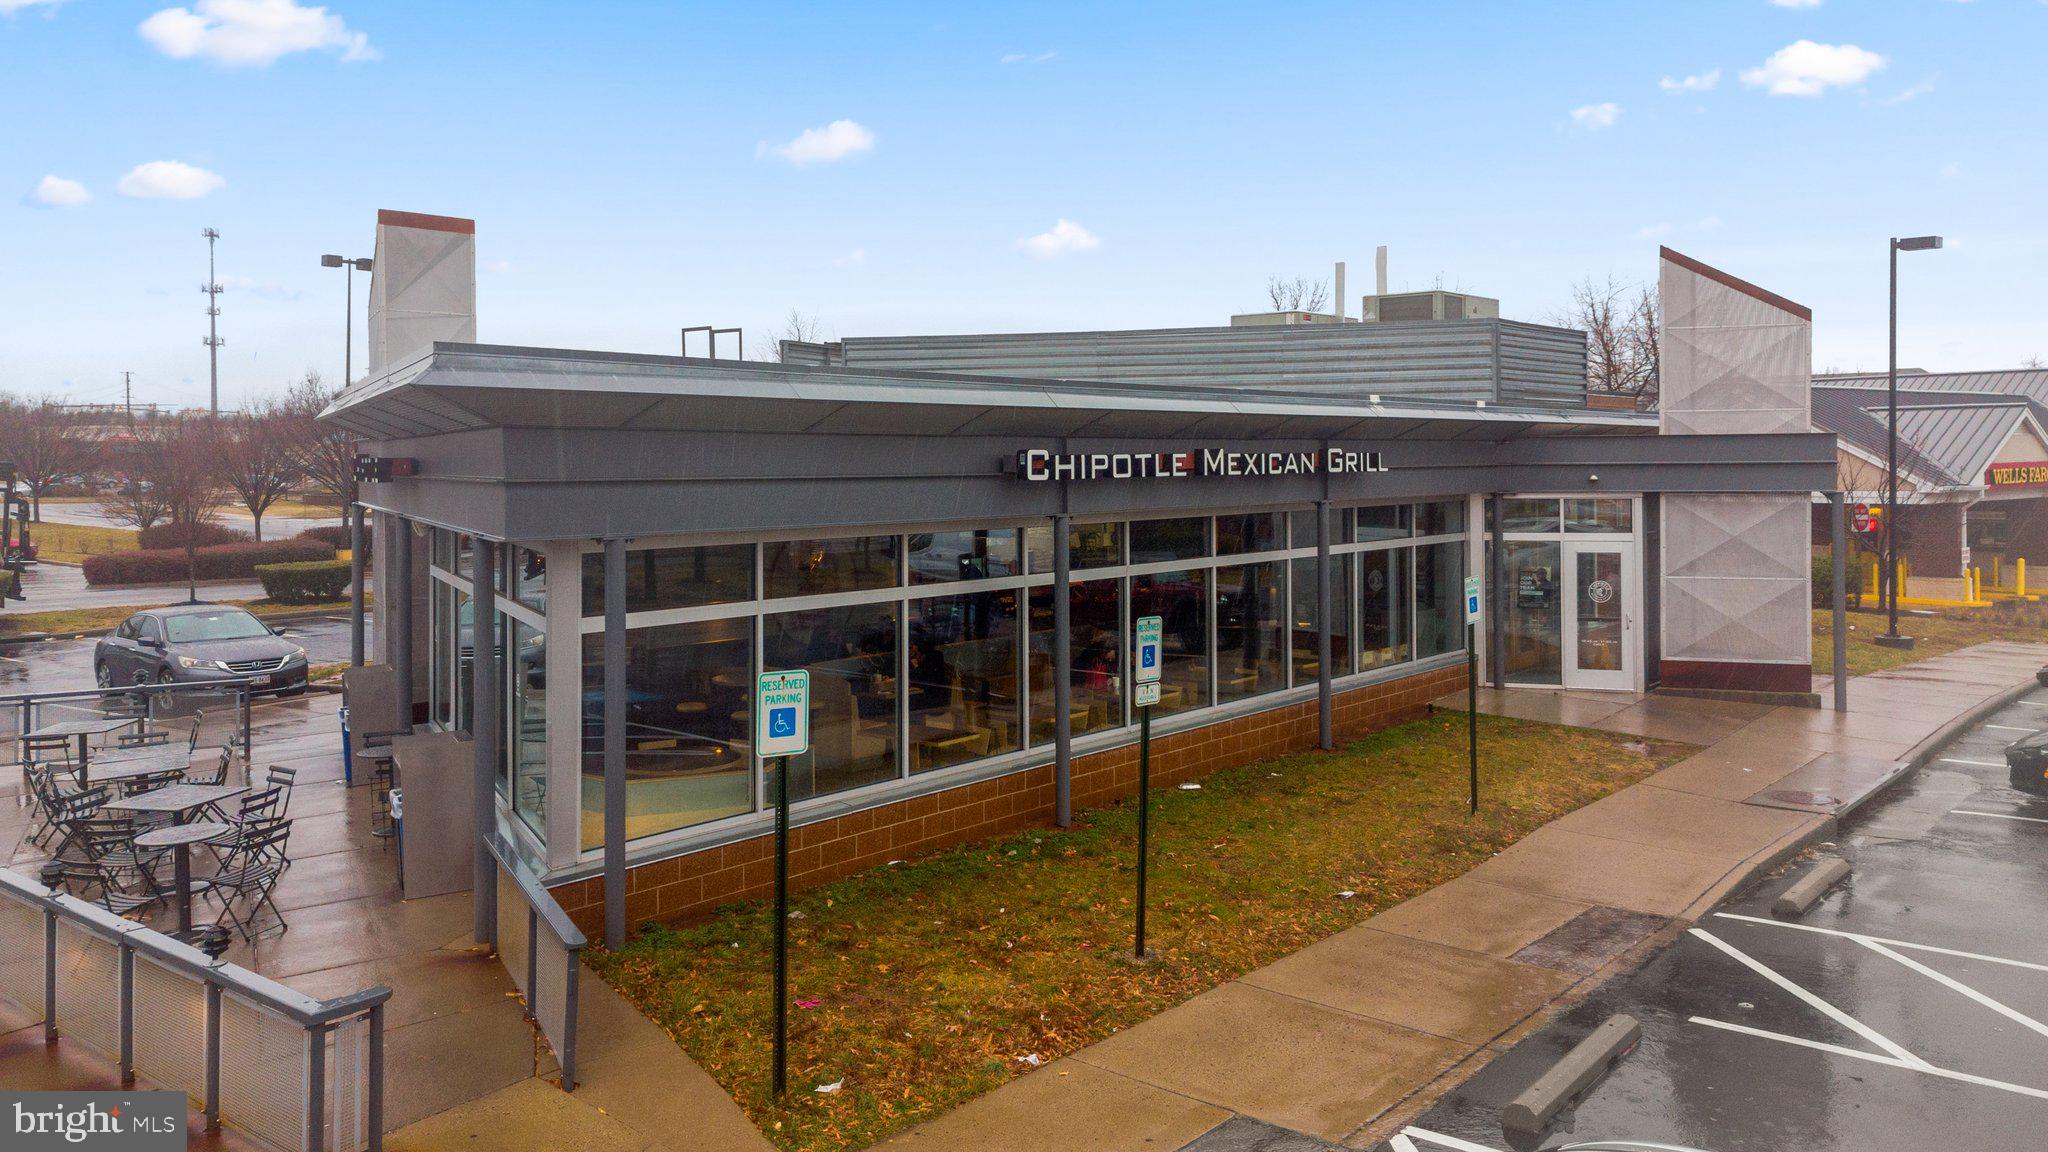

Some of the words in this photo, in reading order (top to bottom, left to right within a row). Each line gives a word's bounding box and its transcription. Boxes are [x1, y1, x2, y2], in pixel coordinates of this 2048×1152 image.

[1026, 448, 1188, 481] CHIPOTLE
[1203, 447, 1315, 476] MEXICAN
[1327, 447, 1389, 473] GRILL
[1993, 467, 2028, 485] WELLS
[2029, 466, 2048, 483] FAR
[761, 678, 805, 692] RESERVED
[765, 693, 802, 706] PARKING
